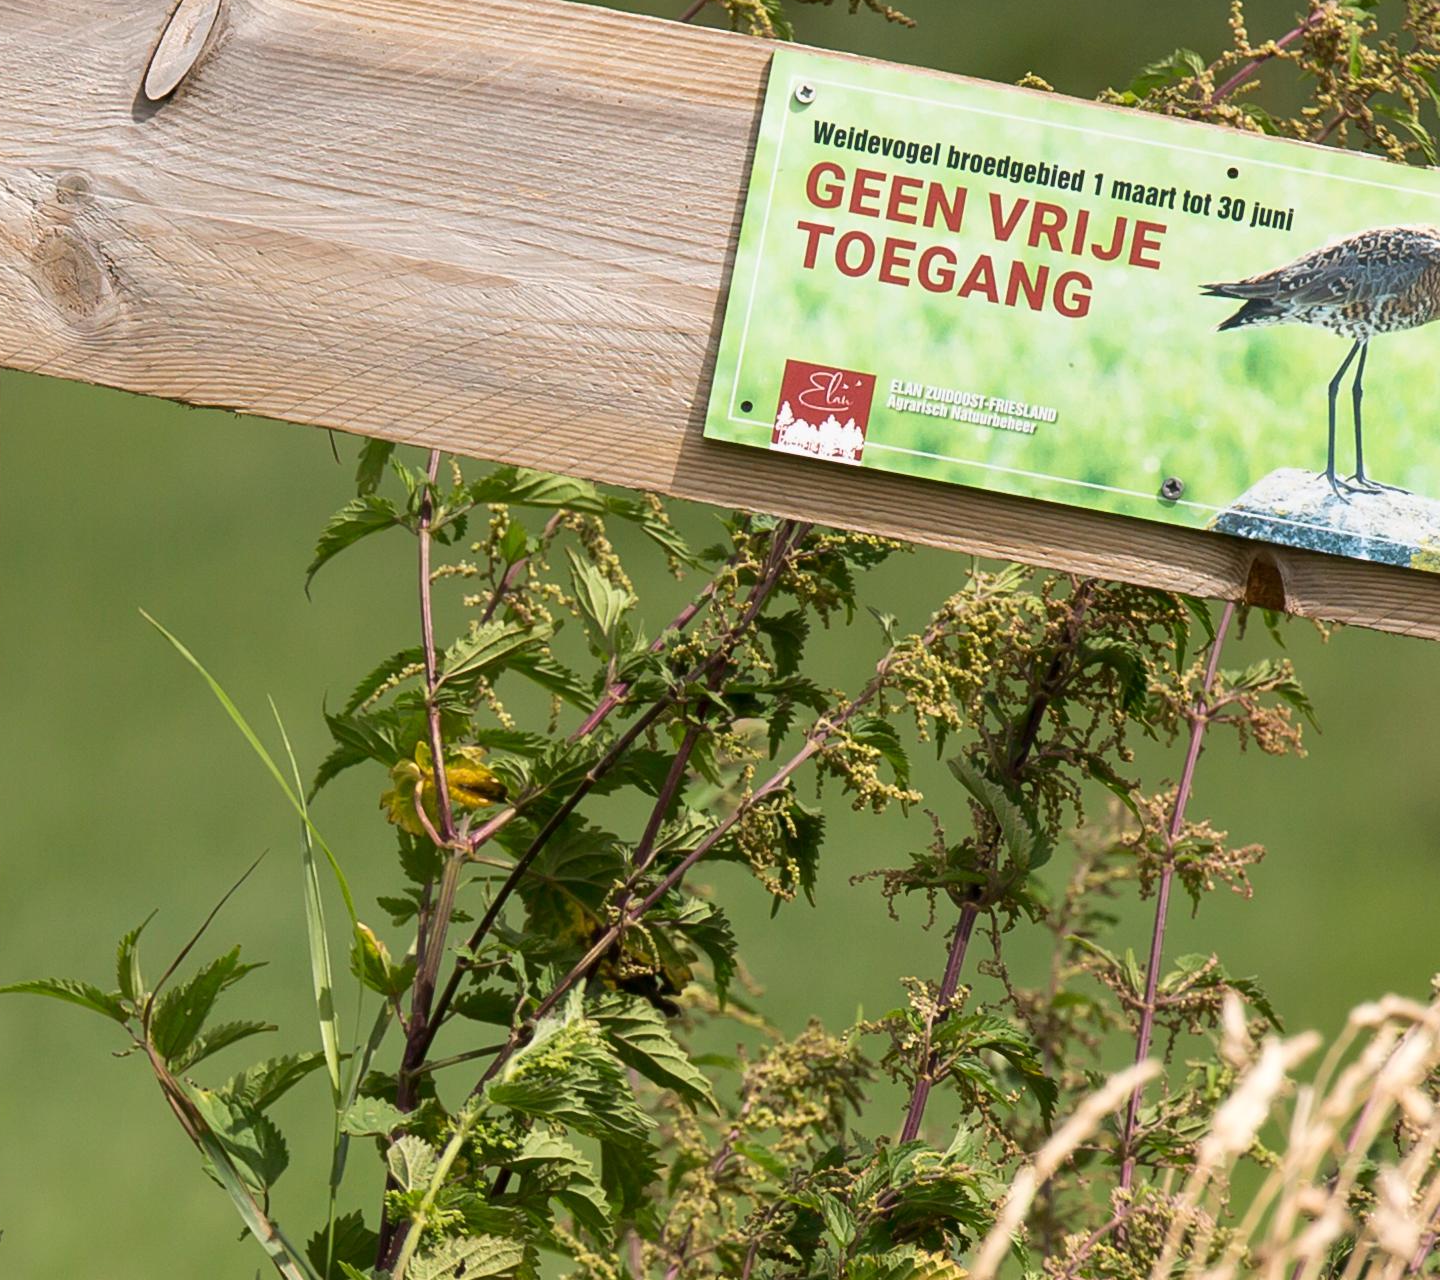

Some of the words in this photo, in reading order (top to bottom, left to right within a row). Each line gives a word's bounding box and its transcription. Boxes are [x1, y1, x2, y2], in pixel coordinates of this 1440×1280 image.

[805, 161, 967, 233] GEEN
[988, 193, 1167, 270] VRIJE
[813, 120, 941, 166] Weidevogel
[947, 147, 1085, 192] broedgebied
[1093, 173, 1104, 196] 1
[1111, 178, 1177, 210] maart
[1182, 189, 1211, 216] tot
[1217, 197, 1245, 222] 30
[1250, 201, 1295, 232] juni
[796, 220, 1093, 319] TOEGANG
[887, 394, 948, 419] Agrarisch
[950, 404, 1037, 434] Natuurbeheer
[890, 379, 923, 400] ELAN
[925, 384, 1058, 423] ZUIDOOST-FRIESLAND
